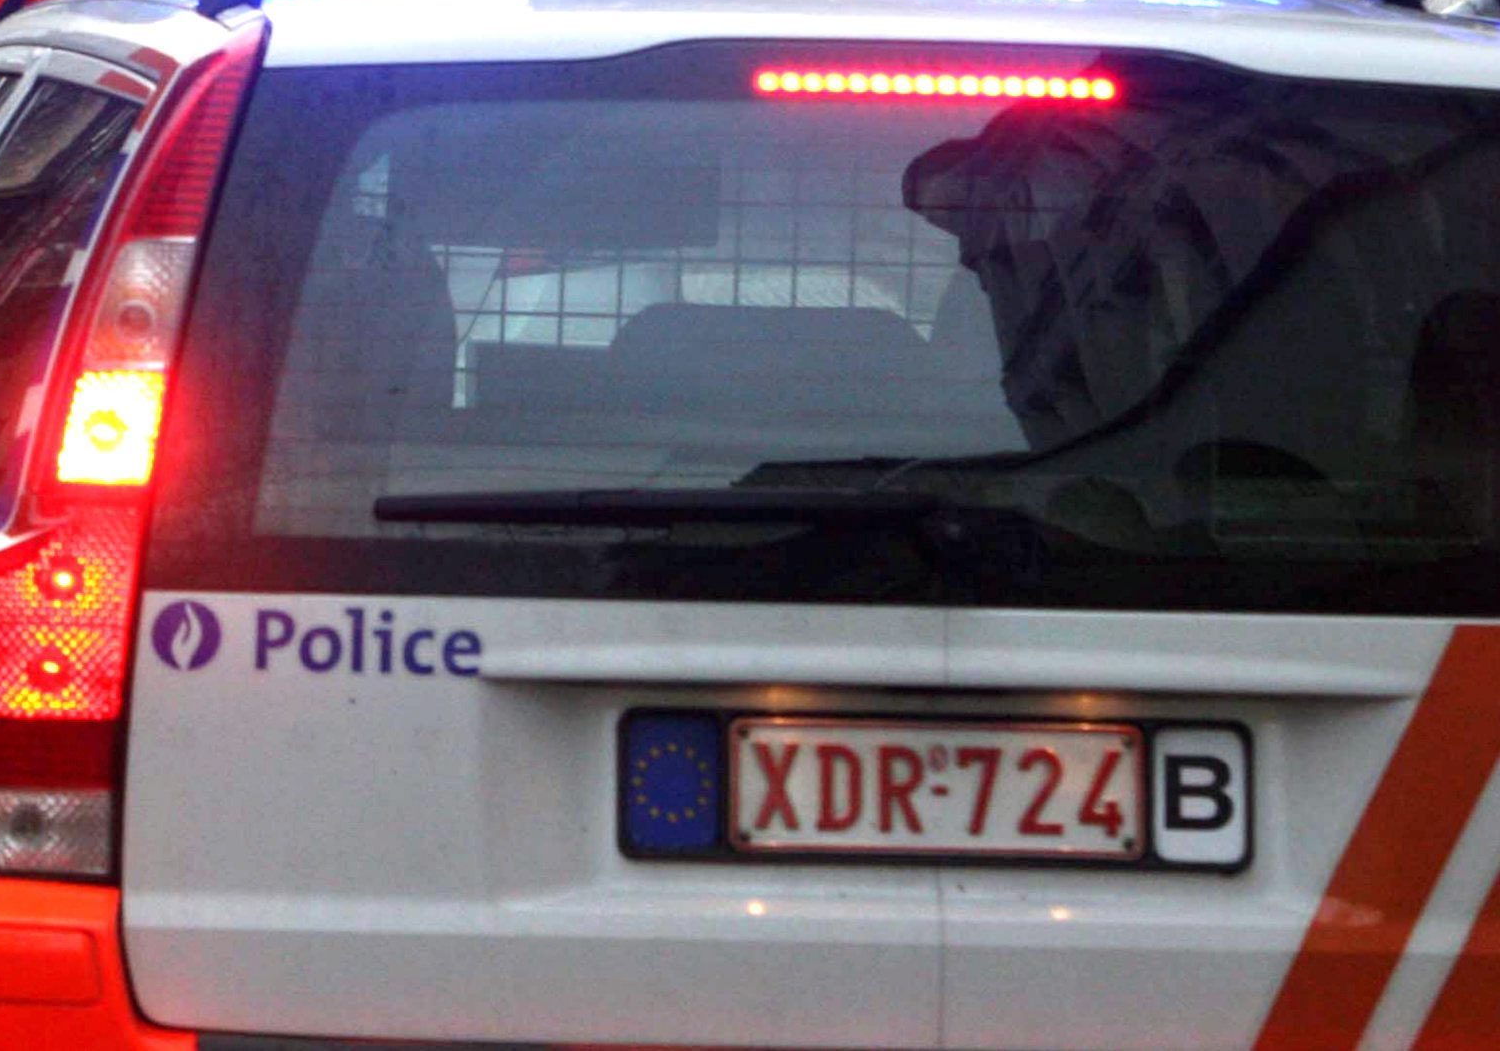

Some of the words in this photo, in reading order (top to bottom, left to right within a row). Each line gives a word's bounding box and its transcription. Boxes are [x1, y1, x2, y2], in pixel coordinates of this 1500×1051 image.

[255, 606, 482, 676] Police
[751, 740, 1125, 839] XDR-724
[1163, 754, 1237, 832] B
